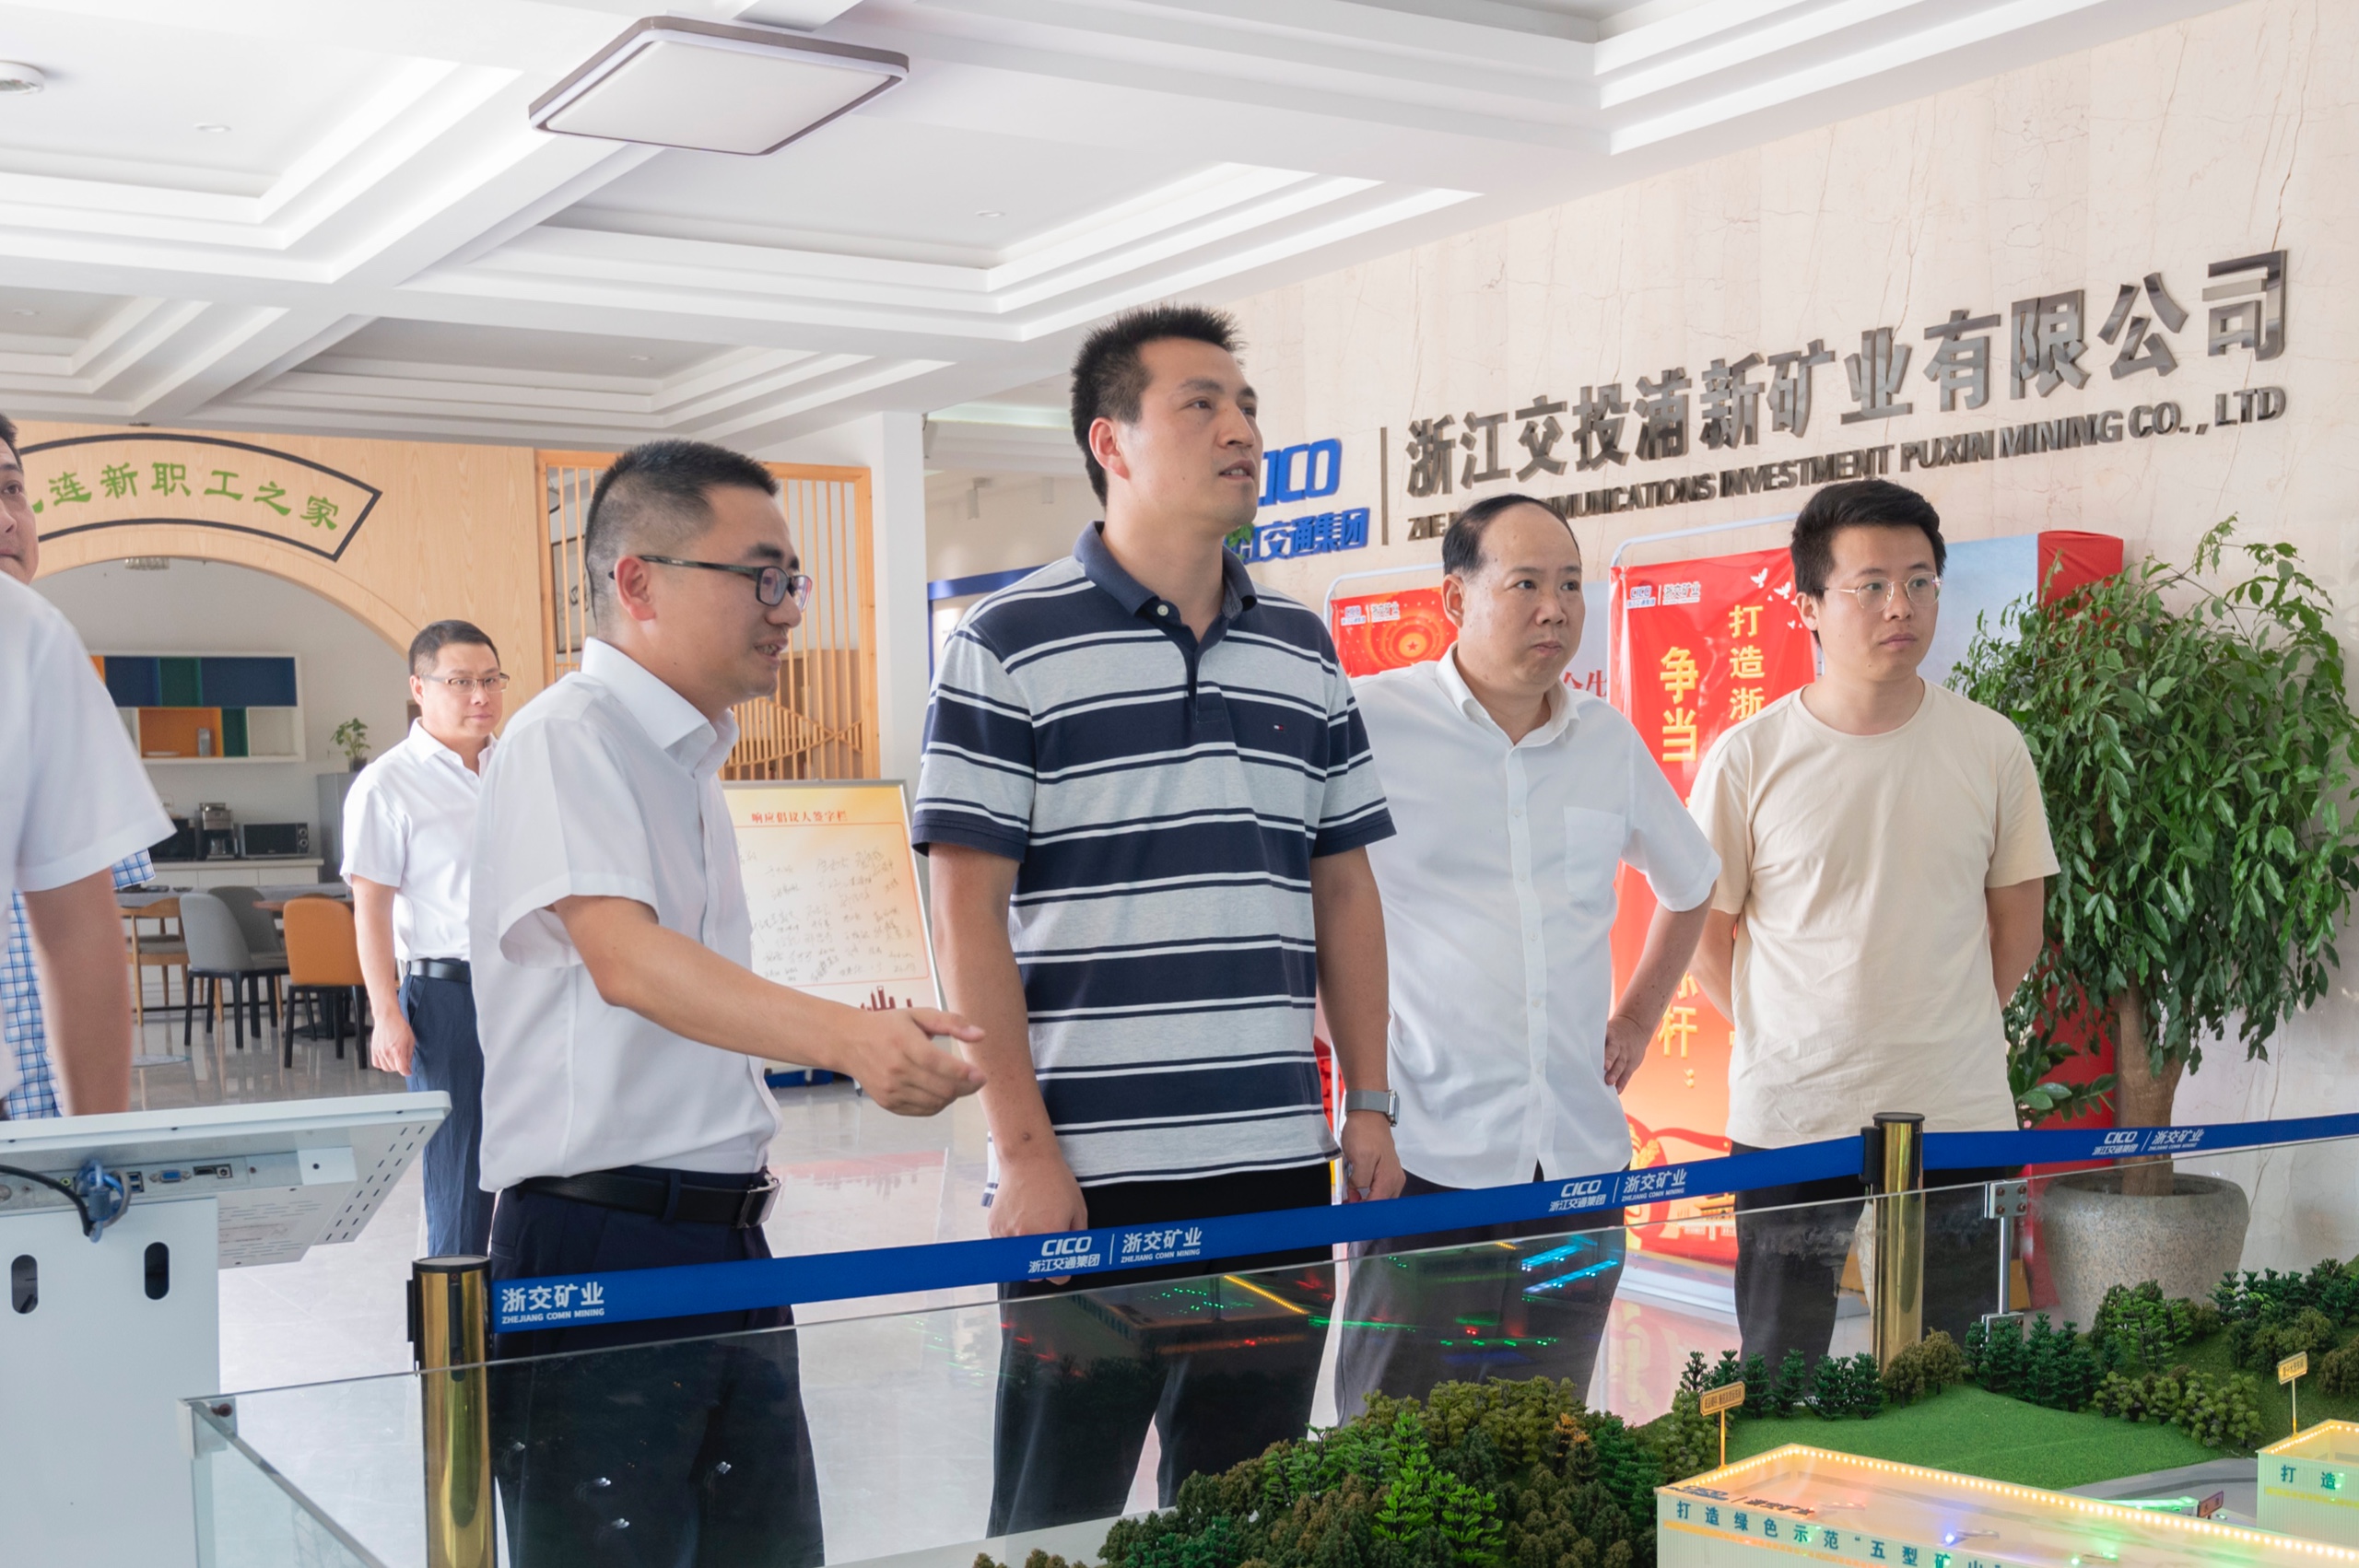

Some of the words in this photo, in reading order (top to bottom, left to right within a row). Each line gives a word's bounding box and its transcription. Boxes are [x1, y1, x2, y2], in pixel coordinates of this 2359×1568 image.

[1406, 250, 2287, 497] 浙江交投浦新矿业有限公司
[1719, 444, 1895, 497] INVESTMENT
[1900, 429, 1995, 472] PUXIN
[1999, 410, 2124, 458] MINING
[1258, 438, 1343, 507] ICO
[31, 462, 340, 531] 连新职工之家
[1231, 508, 1370, 565] 江交通集团
[2104, 1131, 2138, 1144] CICO
[2152, 1129, 2204, 1145] 浙交矿业
[1561, 1179, 1602, 1198] CICO
[1624, 1168, 1687, 1194] 浙交矿业
[1548, 1194, 1606, 1212] 浙江交通集团
[1621, 1194, 1648, 1202] ZHEJIANG
[1665, 1188, 1684, 1196] MINING
[1041, 1236, 1092, 1257] CICO
[1121, 1227, 1203, 1254] 浙交矿业
[1027, 1253, 1100, 1273] 浙江交通集团
[1121, 1254, 1154, 1264] ZHEJIANG
[1156, 1251, 1175, 1260] COMN
[1177, 1248, 1201, 1258] MINING
[501, 1281, 604, 1313] 浙交矿业
[501, 1314, 545, 1325] ZHEJIANG
[546, 1311, 571, 1320] COMN
[574, 1308, 604, 1318] MINING
